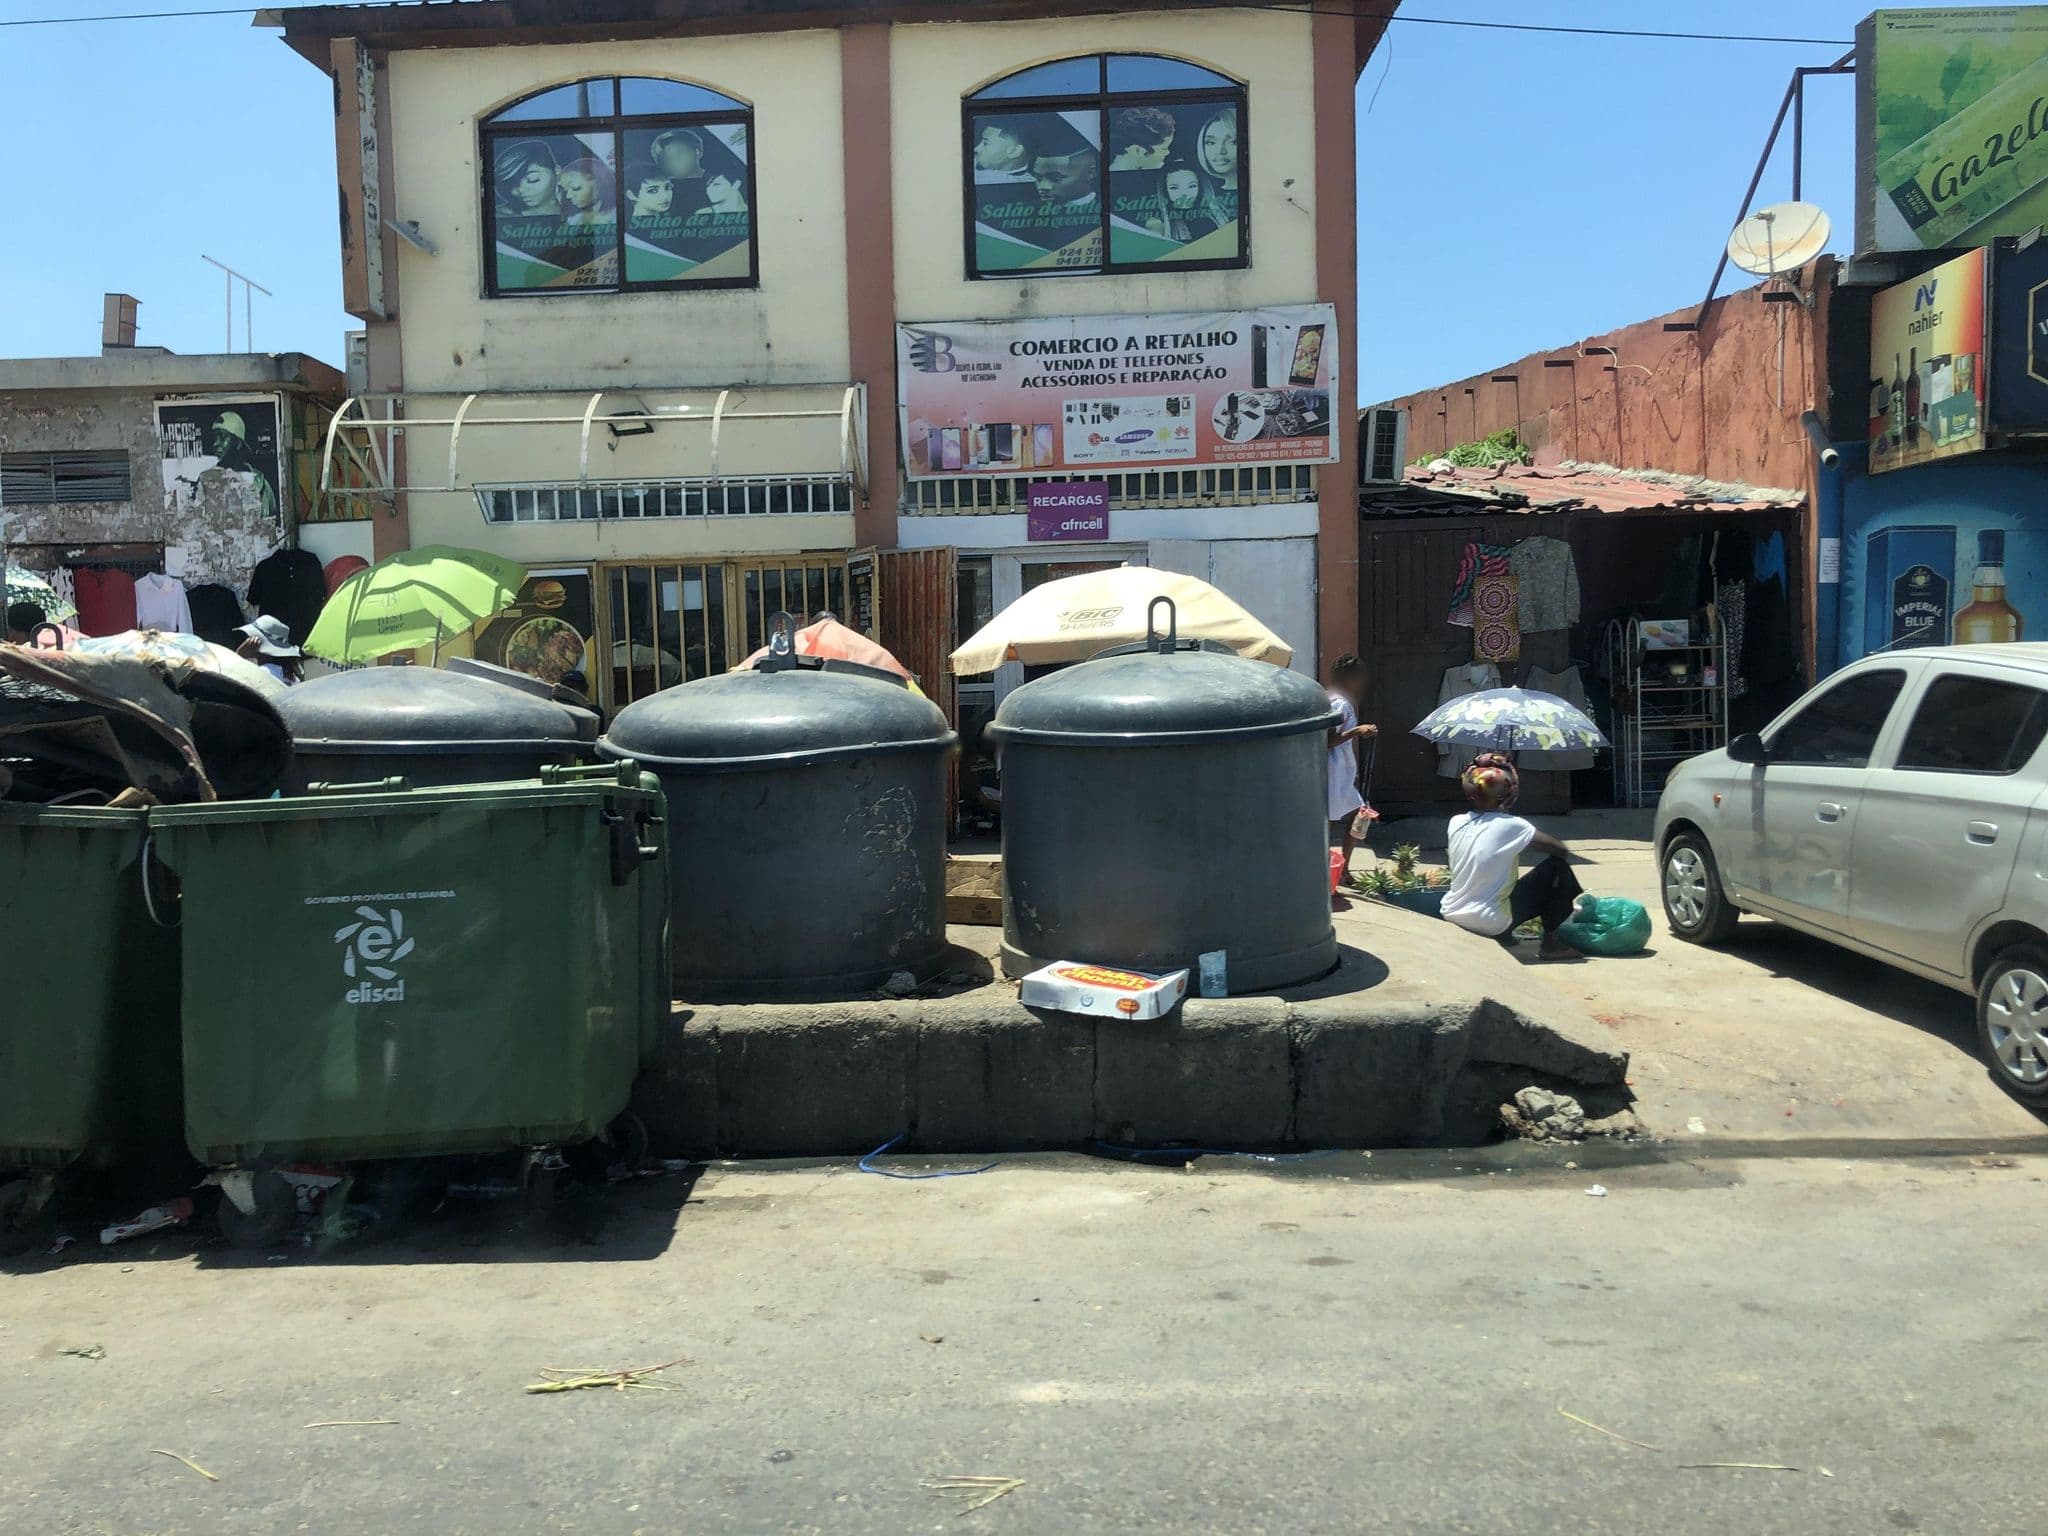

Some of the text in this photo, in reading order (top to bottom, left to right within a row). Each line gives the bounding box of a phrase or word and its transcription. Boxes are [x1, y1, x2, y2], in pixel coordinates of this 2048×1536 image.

[982, 202, 1033, 218] Salão
[1039, 202, 1061, 215] de
[1909, 309, 1944, 337] nahier
[1009, 331, 1238, 357] COMERCIO A RETALHO
[1043, 353, 1205, 372] VENDA DE TELEFONES
[1021, 366, 1227, 388] ACESSÓRIOS E REPARAÇÃO
[1033, 495, 1103, 507] RECARGAS
[1061, 518, 1103, 530] africell
[1074, 609, 1119, 620] BIC
[1895, 602, 1944, 617] IMPERIAL
[1905, 616, 1935, 627] BLUE
[345, 979, 404, 1003] elisal
